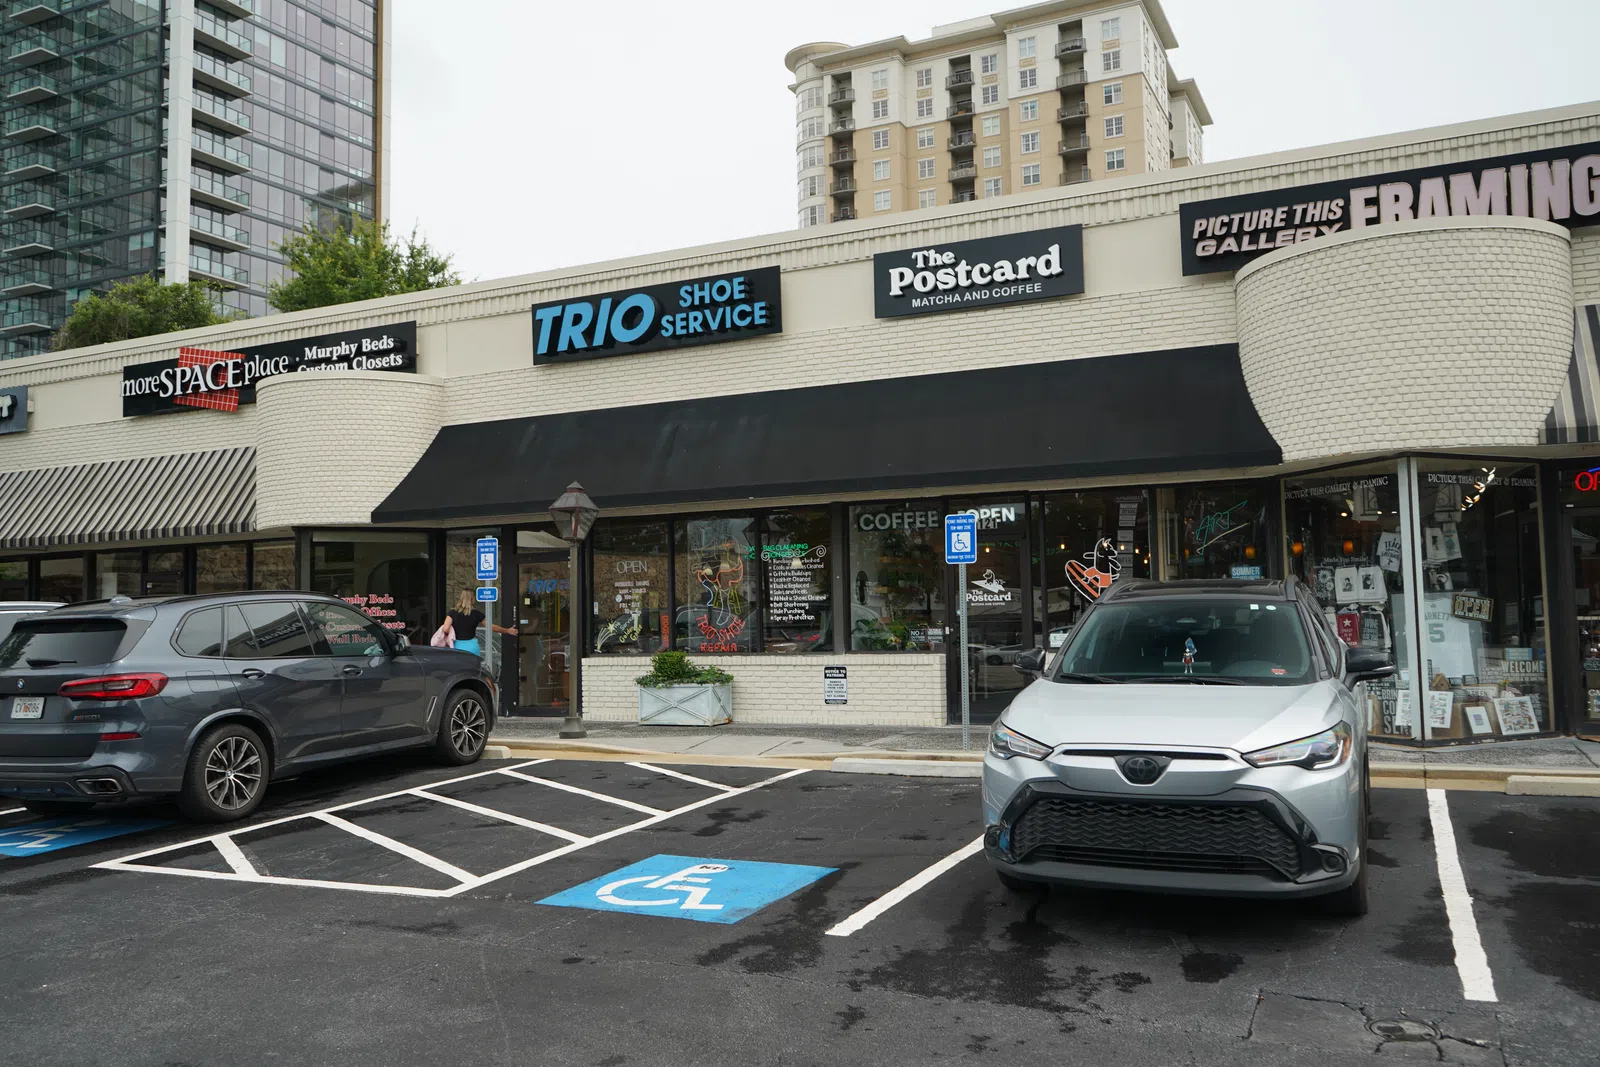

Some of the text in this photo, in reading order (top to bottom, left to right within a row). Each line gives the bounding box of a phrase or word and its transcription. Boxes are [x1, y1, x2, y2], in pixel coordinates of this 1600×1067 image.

[1193, 198, 1344, 239] PICTURE THIS
[1195, 222, 1343, 257] GALLERY
[912, 249, 956, 268] The
[888, 244, 1063, 296] Postcard
[679, 276, 745, 308] SHOE
[912, 283, 1042, 307] MATCHA AND COFFEE
[535, 292, 656, 355] TRIO
[660, 301, 767, 337] SERVICE
[304, 335, 394, 361] Murphy Beds
[352, 354, 403, 371] Closets
[1360, 476, 1389, 489] FRAMING
[1428, 473, 1456, 483] PICTURE
[860, 510, 939, 531] COFFEE
[617, 560, 648, 573] OPEN
[1232, 566, 1260, 576] SUMMER
[528, 579, 557, 593] TRIO
[369, 594, 394, 604] Beds
[966, 592, 1012, 601] Postcard
[718, 616, 746, 642] SHOE
[1429, 623, 1445, 643] 5
[700, 642, 738, 652] REPAIR
[1501, 660, 1545, 673] WELCOME
